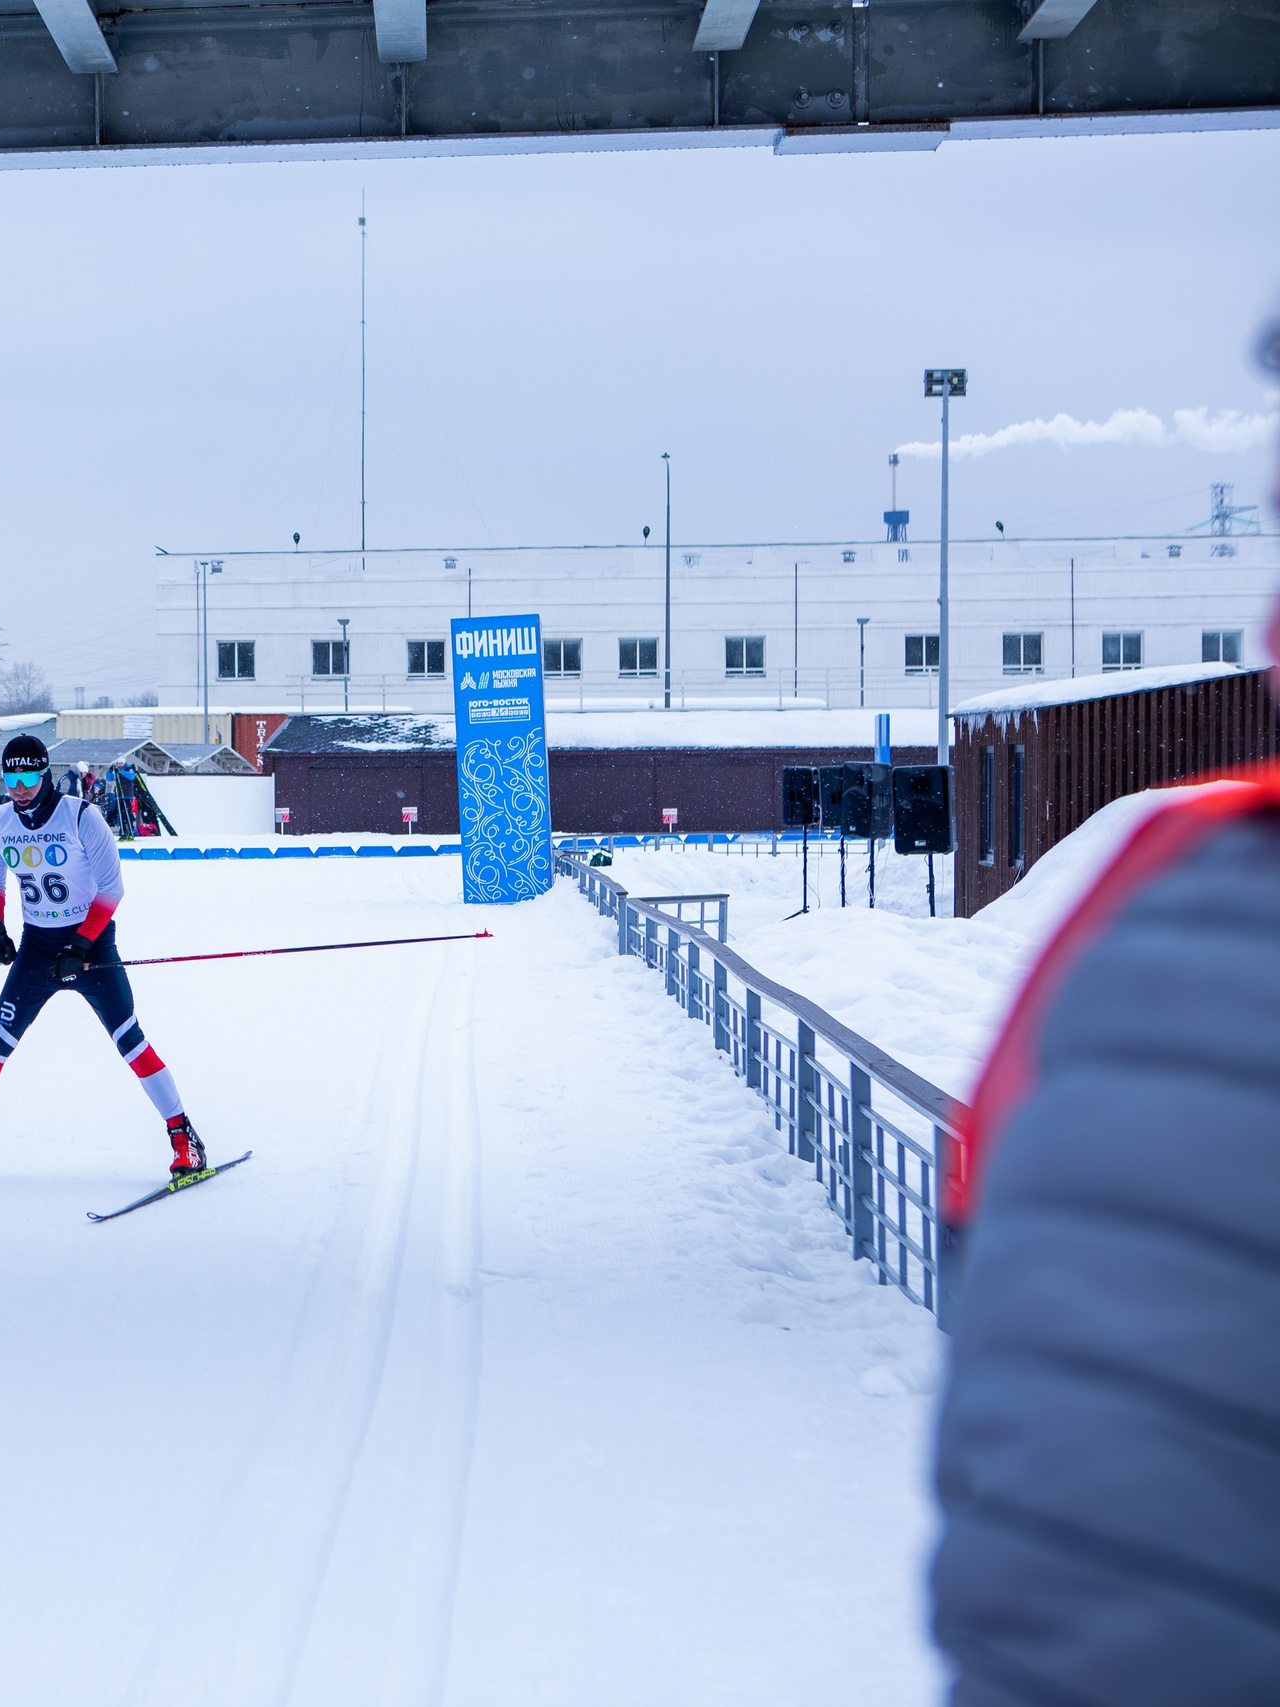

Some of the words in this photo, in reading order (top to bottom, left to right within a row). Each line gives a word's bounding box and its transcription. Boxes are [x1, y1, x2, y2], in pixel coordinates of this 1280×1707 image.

[455, 627, 537, 659] ФИНИШ
[492, 668, 536, 679] МОСКОВСКАЯ
[493, 679, 518, 689] ЛЫЖНЯ
[469, 698, 530, 708] ЮГО-ВОСТОК
[5, 757, 33, 767] VITAL
[1, 832, 66, 844] VMARAFONE
[16, 872, 70, 905] 56
